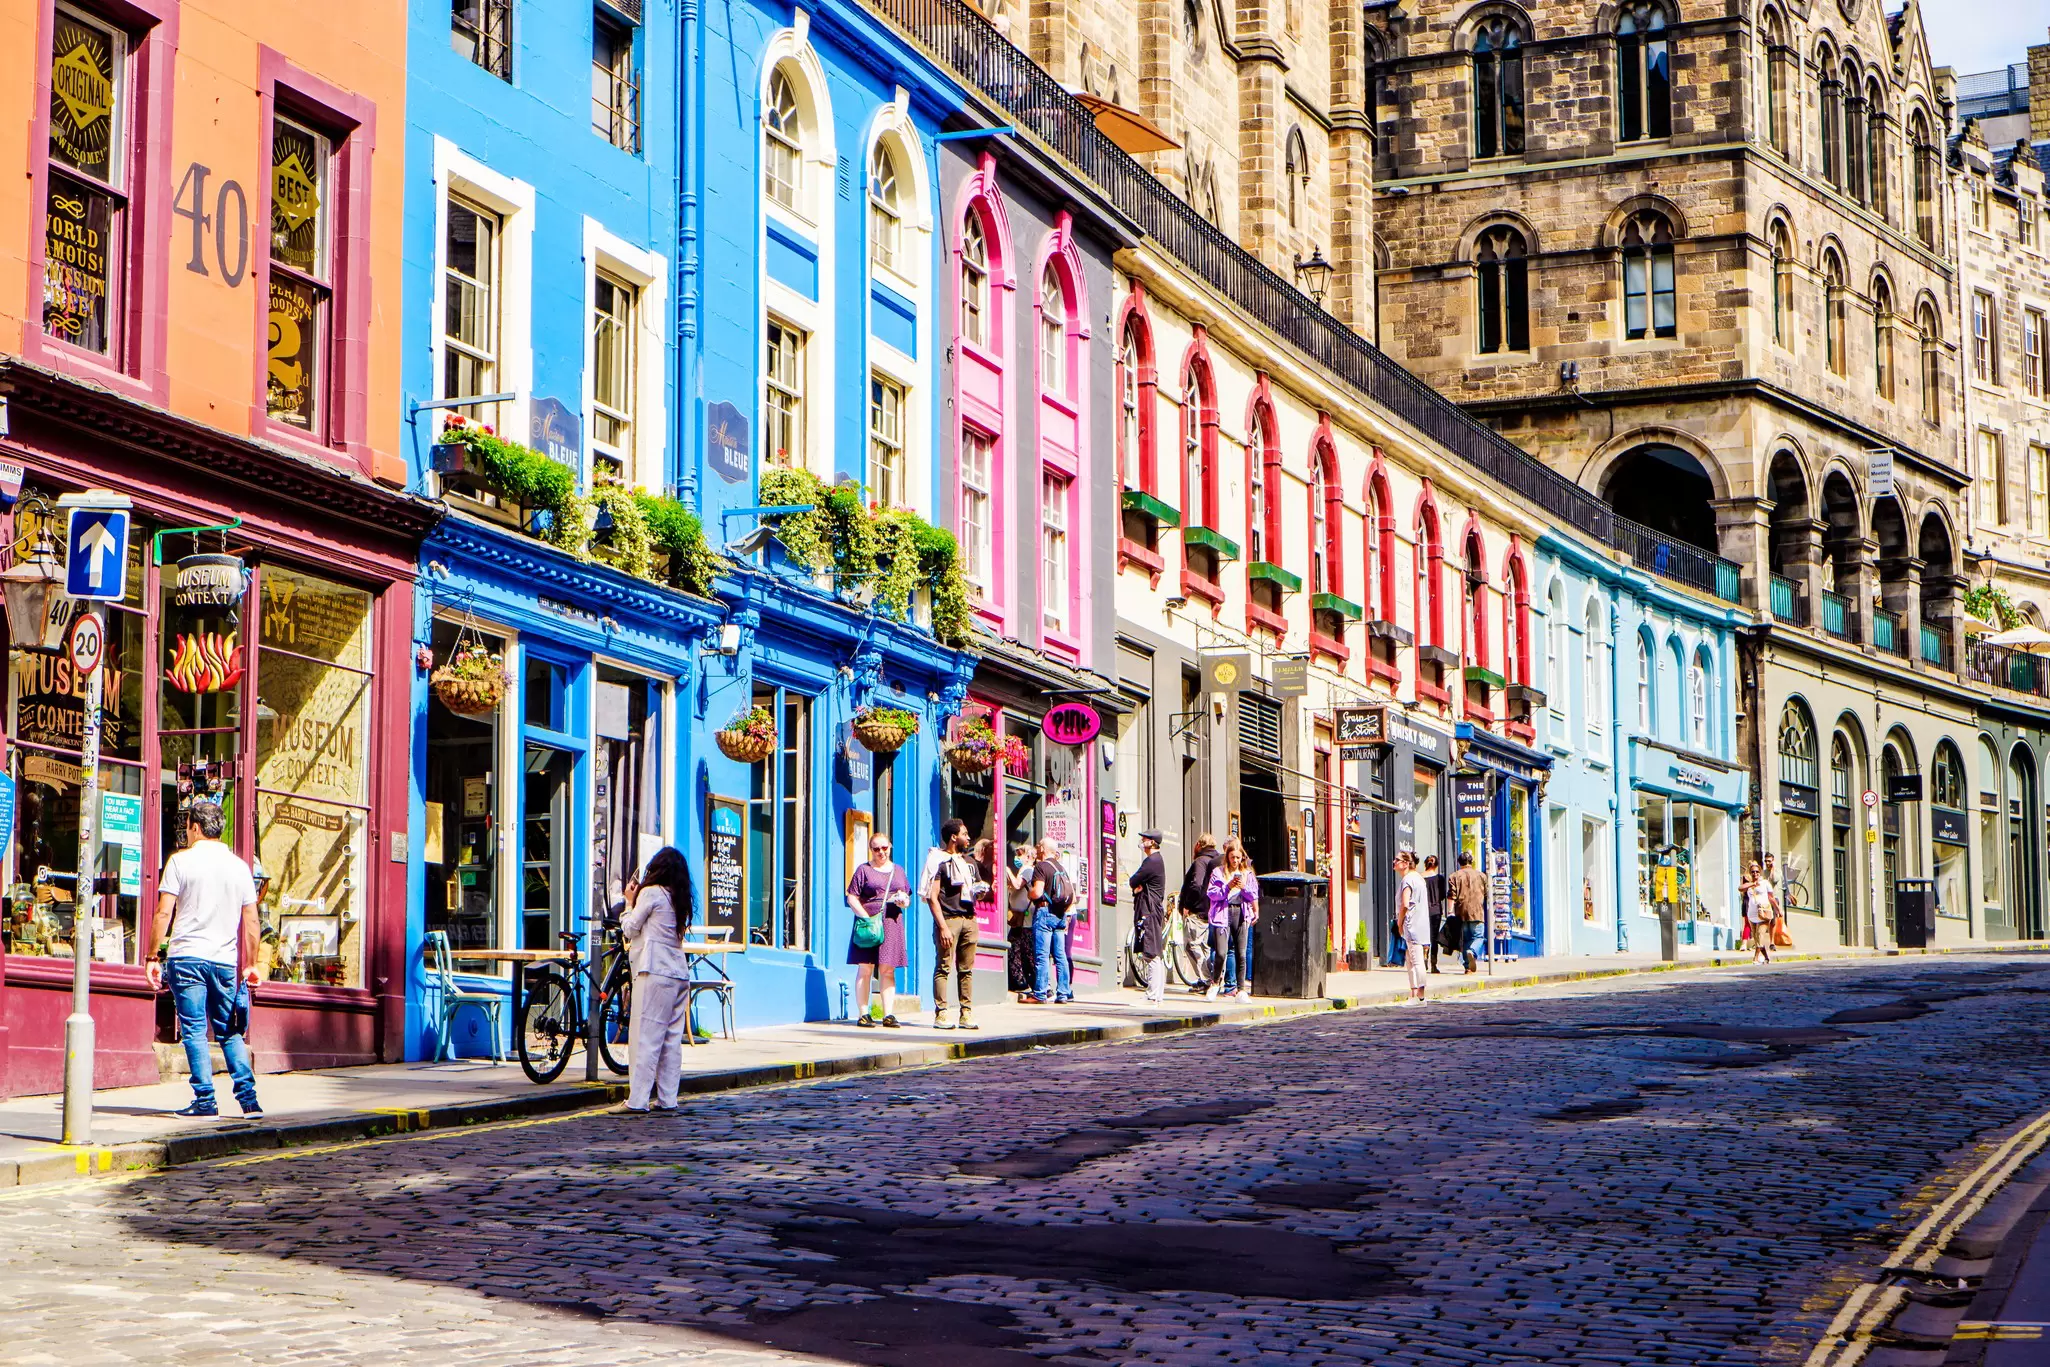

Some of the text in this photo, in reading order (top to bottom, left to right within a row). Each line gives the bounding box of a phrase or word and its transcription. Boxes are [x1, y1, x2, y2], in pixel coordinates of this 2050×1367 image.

[58, 64, 106, 109] ORIGINAL
[278, 175, 310, 209] BEST
[173, 162, 248, 288] 40
[45, 236, 103, 273] AMOUS!
[44, 261, 105, 298] MISSION
[269, 282, 312, 321] PERIOR
[549, 441, 578, 468] BLEUE
[724, 446, 748, 472] BLEUE
[176, 568, 231, 588] MUSEUM
[50, 599, 69, 627] 40
[176, 591, 230, 606] CONTEXT
[75, 632, 98, 656] 20
[18, 649, 121, 719] MUSEM
[37, 704, 83, 736] CONTE
[1390, 714, 1417, 745] WHISKY
[1418, 731, 1437, 751] SHOP
[273, 713, 353, 769] MUSEUM
[1341, 748, 1379, 760] RESTAURANT
[46, 761, 66, 776] HARRY
[68, 767, 82, 780] POT
[287, 757, 337, 786] CONTEXT
[290, 806, 307, 821] HARRY
[307, 811, 327, 827] POTTER
